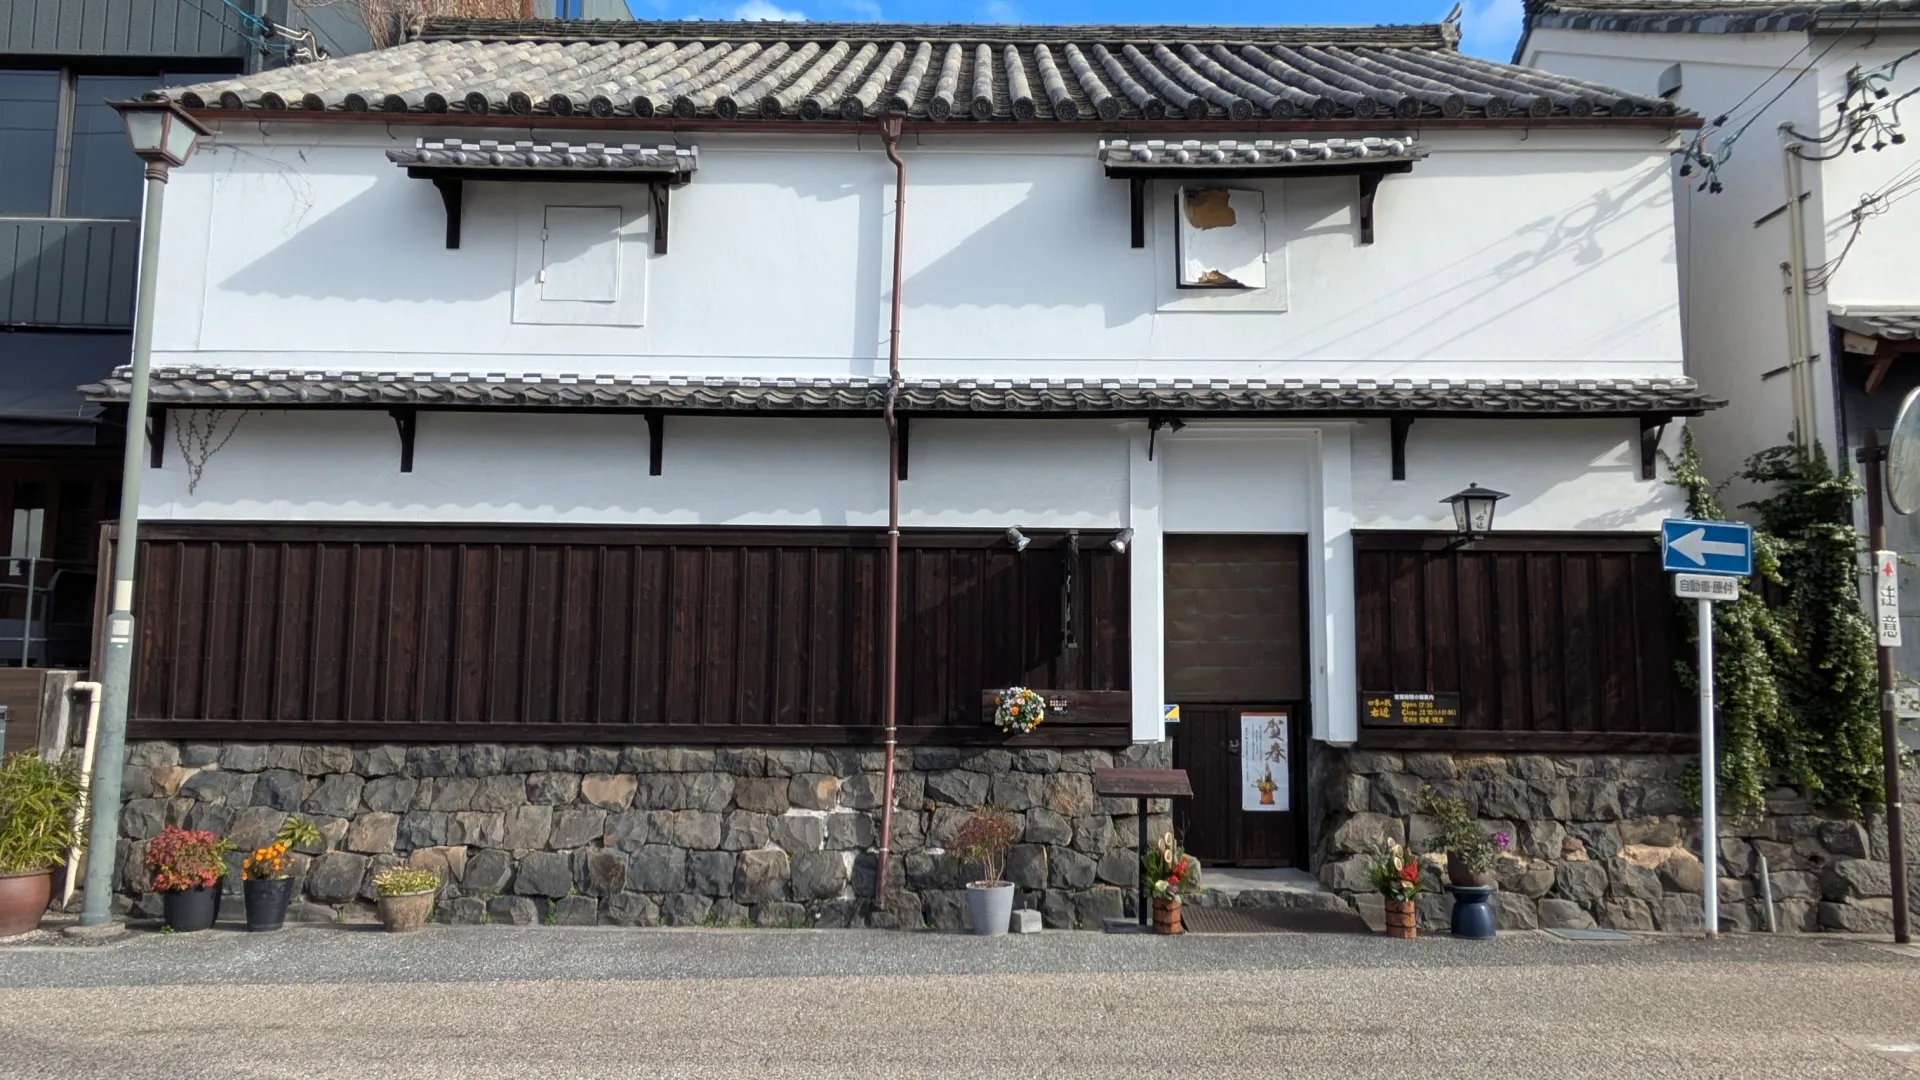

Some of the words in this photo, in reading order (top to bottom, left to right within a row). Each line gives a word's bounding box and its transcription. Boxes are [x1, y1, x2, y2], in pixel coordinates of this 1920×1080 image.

[1880, 585, 1898, 638] 注意
[1370, 707, 1391, 718] 右近
[1401, 701, 1417, 709] Open
[1264, 718, 1286, 763] 賀春
